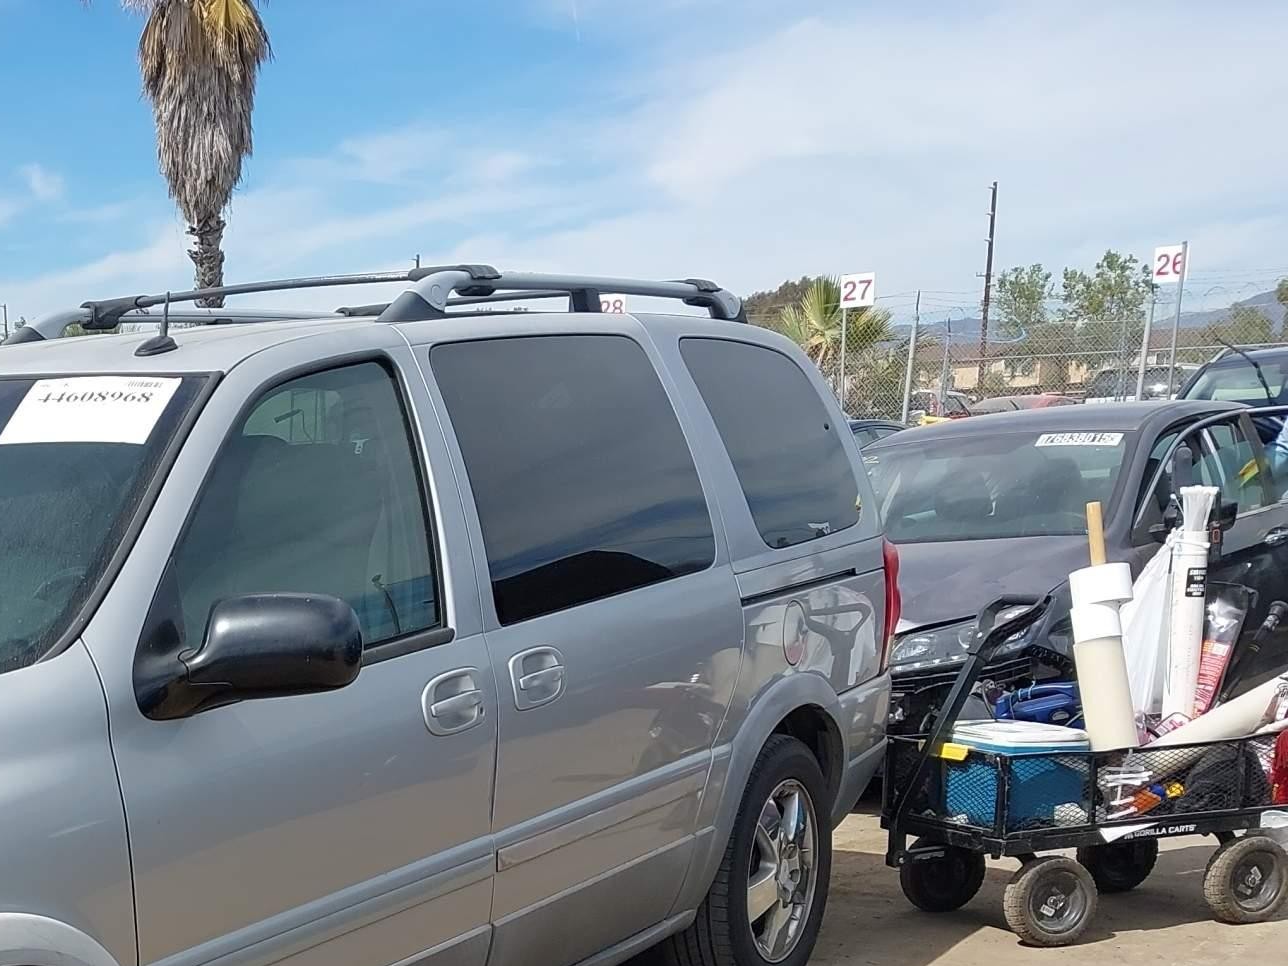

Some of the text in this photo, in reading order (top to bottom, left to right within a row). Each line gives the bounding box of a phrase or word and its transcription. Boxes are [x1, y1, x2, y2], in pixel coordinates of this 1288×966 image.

[1156, 252, 1182, 276] 26
[843, 279, 873, 302] 27
[38, 391, 153, 403] 44608968
[1134, 825, 1196, 837] GORILLA CARTS
